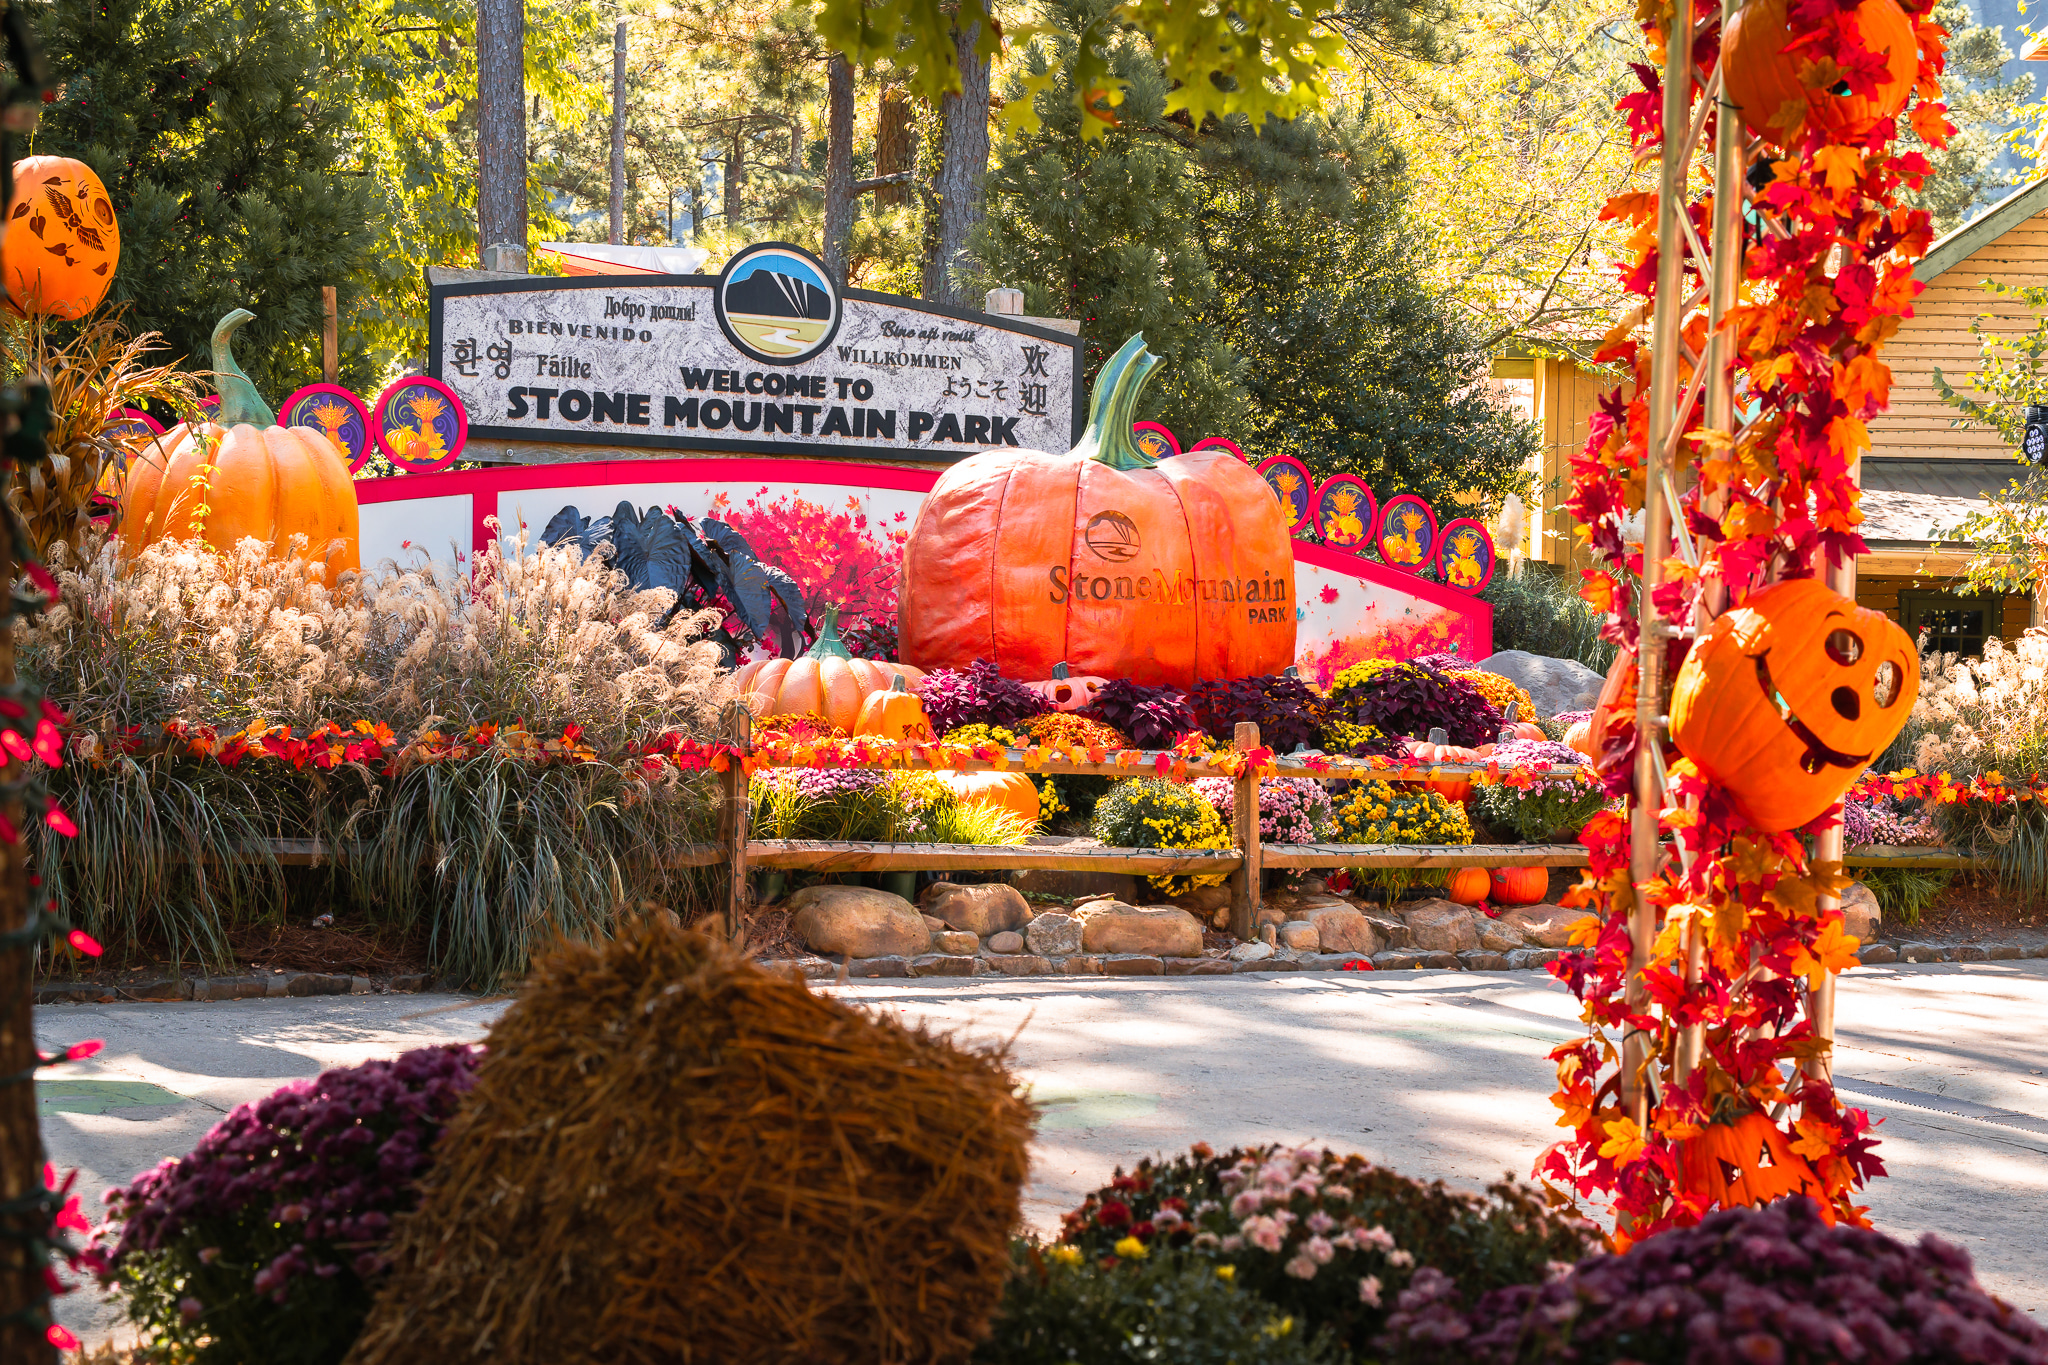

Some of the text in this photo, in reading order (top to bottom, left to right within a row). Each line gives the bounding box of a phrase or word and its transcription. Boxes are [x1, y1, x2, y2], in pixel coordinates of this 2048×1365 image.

[604, 296, 695, 324] Добро дошли!
[508, 319, 653, 343] BIENVENIDO
[536, 354, 591, 379] Fáilte
[837, 346, 962, 370] WILLKOMMEN
[680, 367, 873, 401] WELCOME TO
[942, 376, 1009, 400] ようこそ
[507, 386, 1020, 446] STONE MOUNTAIN PARK
